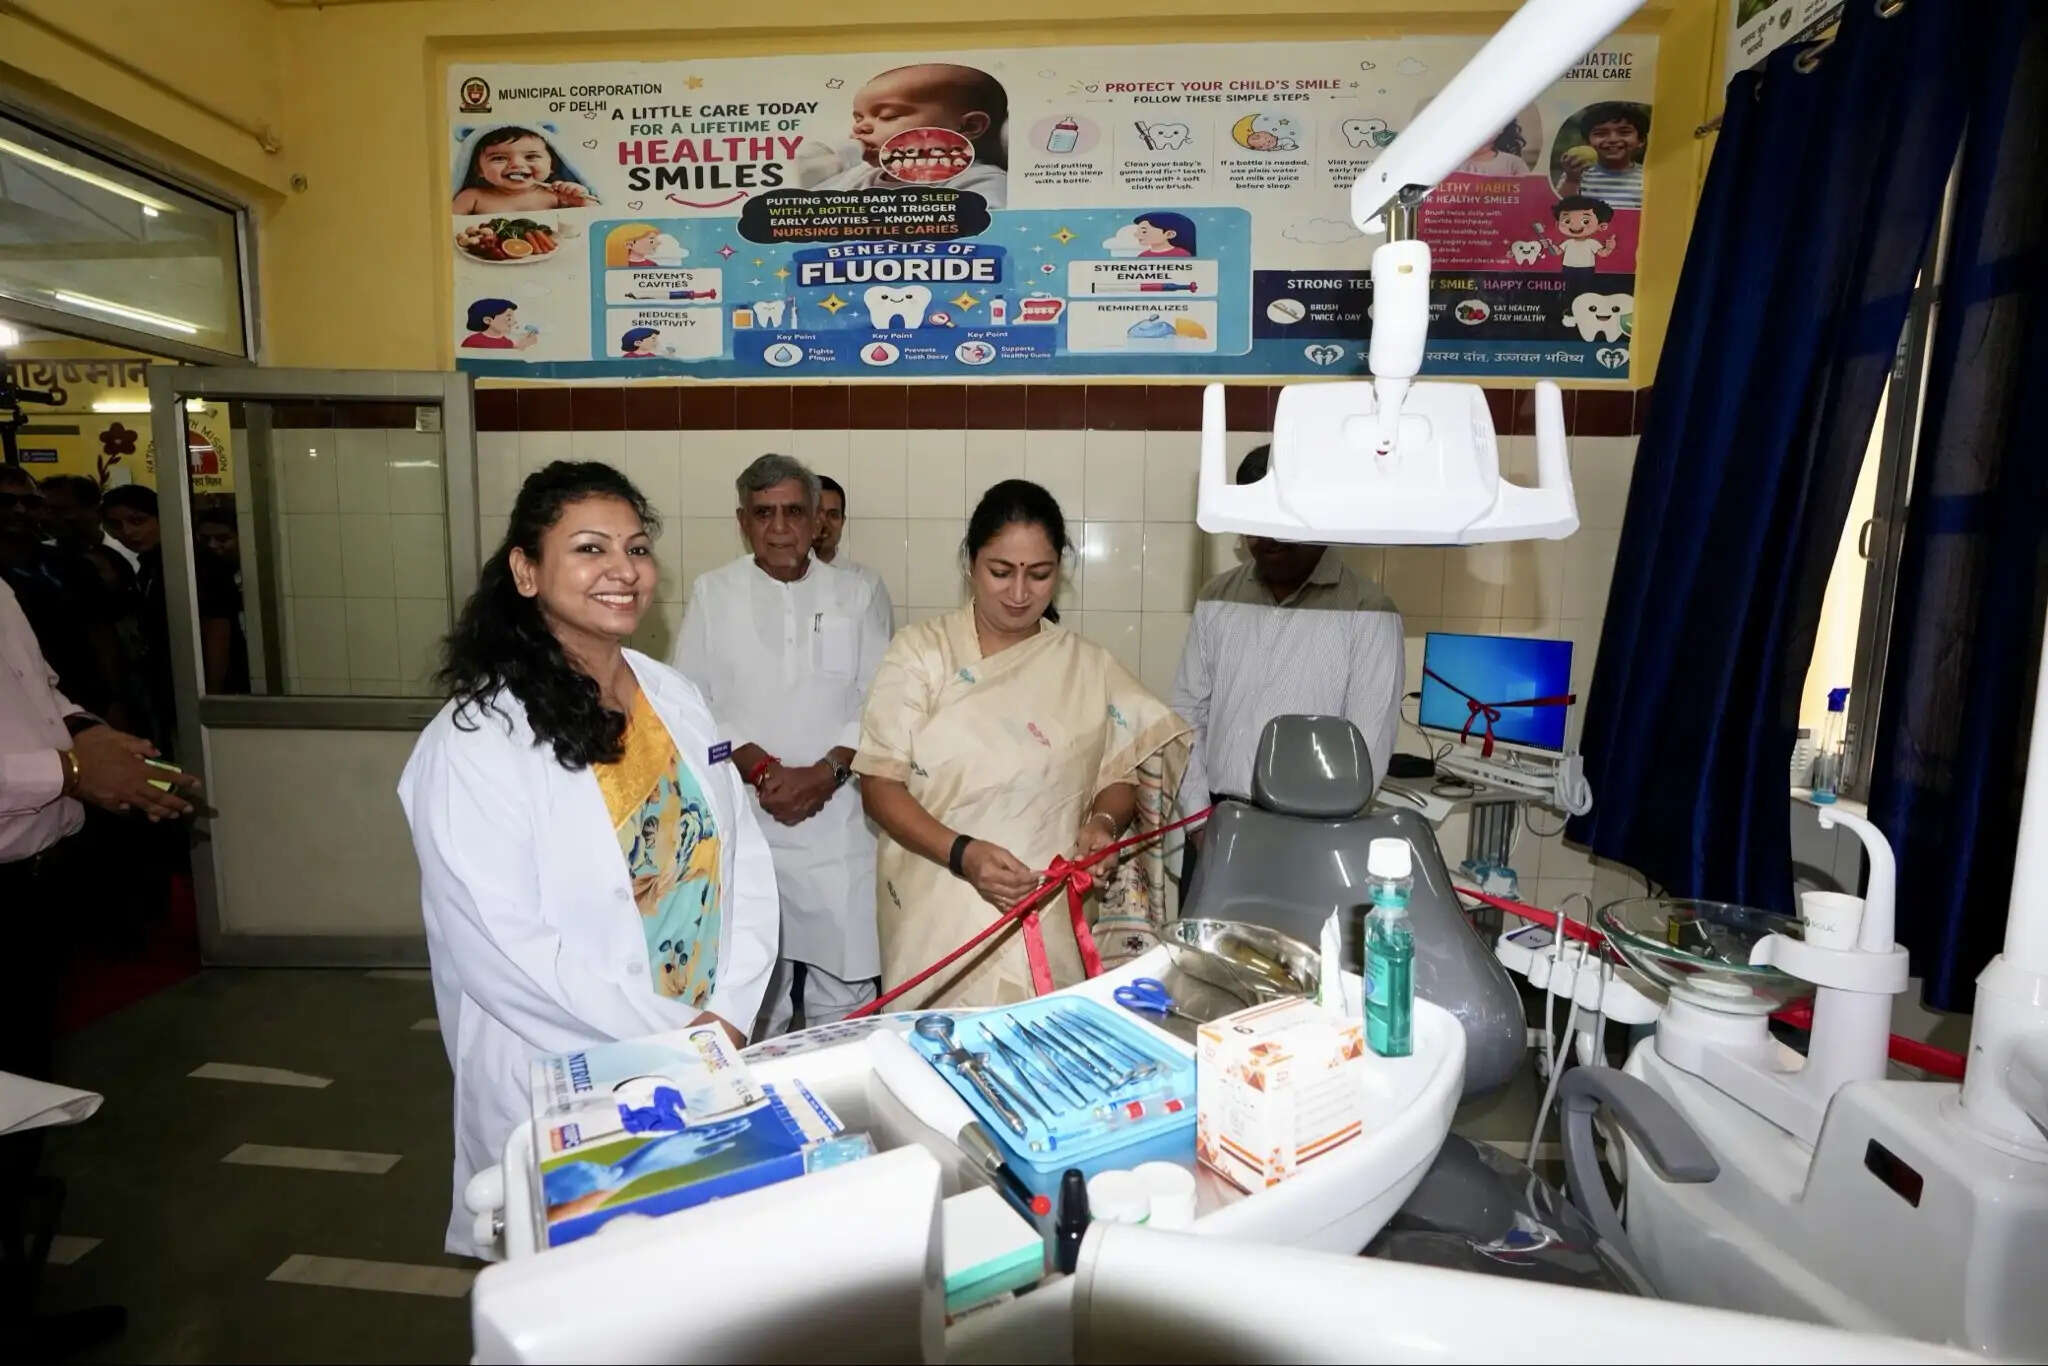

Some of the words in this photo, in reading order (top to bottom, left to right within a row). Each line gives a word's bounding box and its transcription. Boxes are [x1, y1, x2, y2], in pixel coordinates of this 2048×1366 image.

[1566, 69, 1600, 79] ENTAL
[1603, 69, 1632, 79] CARE
[498, 86, 566, 100] MUNICIPAL
[570, 83, 662, 98] CORPORATION
[1105, 82, 1175, 93] PROTECT
[1181, 81, 1224, 92] YOUR
[1229, 80, 1292, 91] CHILD'S
[1295, 79, 1341, 90] SMILE
[1134, 95, 1182, 104] FOLLOW
[1186, 94, 1222, 103] THESE
[1226, 93, 1269, 103] SIMPLE
[1272, 93, 1310, 102] STEPS
[549, 101, 566, 113] OF
[569, 101, 607, 112] DELHI
[611, 108, 624, 120] A
[632, 106, 693, 120] LITTLE
[700, 104, 751, 117] CARE
[759, 102, 818, 116] TODAY
[630, 122, 662, 135] FOR
[671, 122, 683, 134] A
[691, 120, 769, 134] LIFETIME
[778, 119, 800, 131] OF
[619, 136, 803, 166] HEALTHY
[628, 163, 783, 192] SMILES
[1440, 183, 1471, 192] LTHY
[1477, 183, 1521, 193] HABITS
[766, 197, 822, 207] PUTTING
[825, 195, 859, 205] YOUR
[863, 194, 897, 204] BABY
[900, 193, 918, 203] TO
[921, 193, 960, 202] SLEEP
[1437, 196, 1481, 204] HEALTHY
[1483, 196, 1520, 204] SMILES
[769, 206, 801, 216] WITH
[805, 206, 815, 215] A
[819, 205, 865, 215] BOTTLE
[869, 204, 898, 214] CAN
[901, 203, 957, 213] TRIGGER
[770, 217, 809, 226] EARLY
[812, 216, 869, 225] CAVITIES
[884, 215, 933, 224] KNOWN
[938, 214, 955, 223] AS
[772, 226, 840, 238] NURSING
[844, 225, 900, 237] BOTTLE
[904, 224, 959, 234] CARIES
[827, 243, 936, 258] BENEFITS
[947, 243, 976, 255] OF
[802, 259, 995, 284] FLUORIDE
[1094, 264, 1193, 272] STRENGTHENS
[633, 273, 694, 281] PREVENTS
[1287, 279, 1343, 289] STRONG
[1348, 279, 1373, 289] TEE
[1484, 280, 1524, 290] HAPPY
[1527, 280, 1567, 291] CHILD!
[1508, 304, 1540, 312] HEALTHY
[639, 311, 689, 319] REDUCES
[1513, 314, 1546, 322] HEALTHY
[631, 319, 697, 327] SENSITIVITY
[569, 1052, 593, 1094] NITRILE
